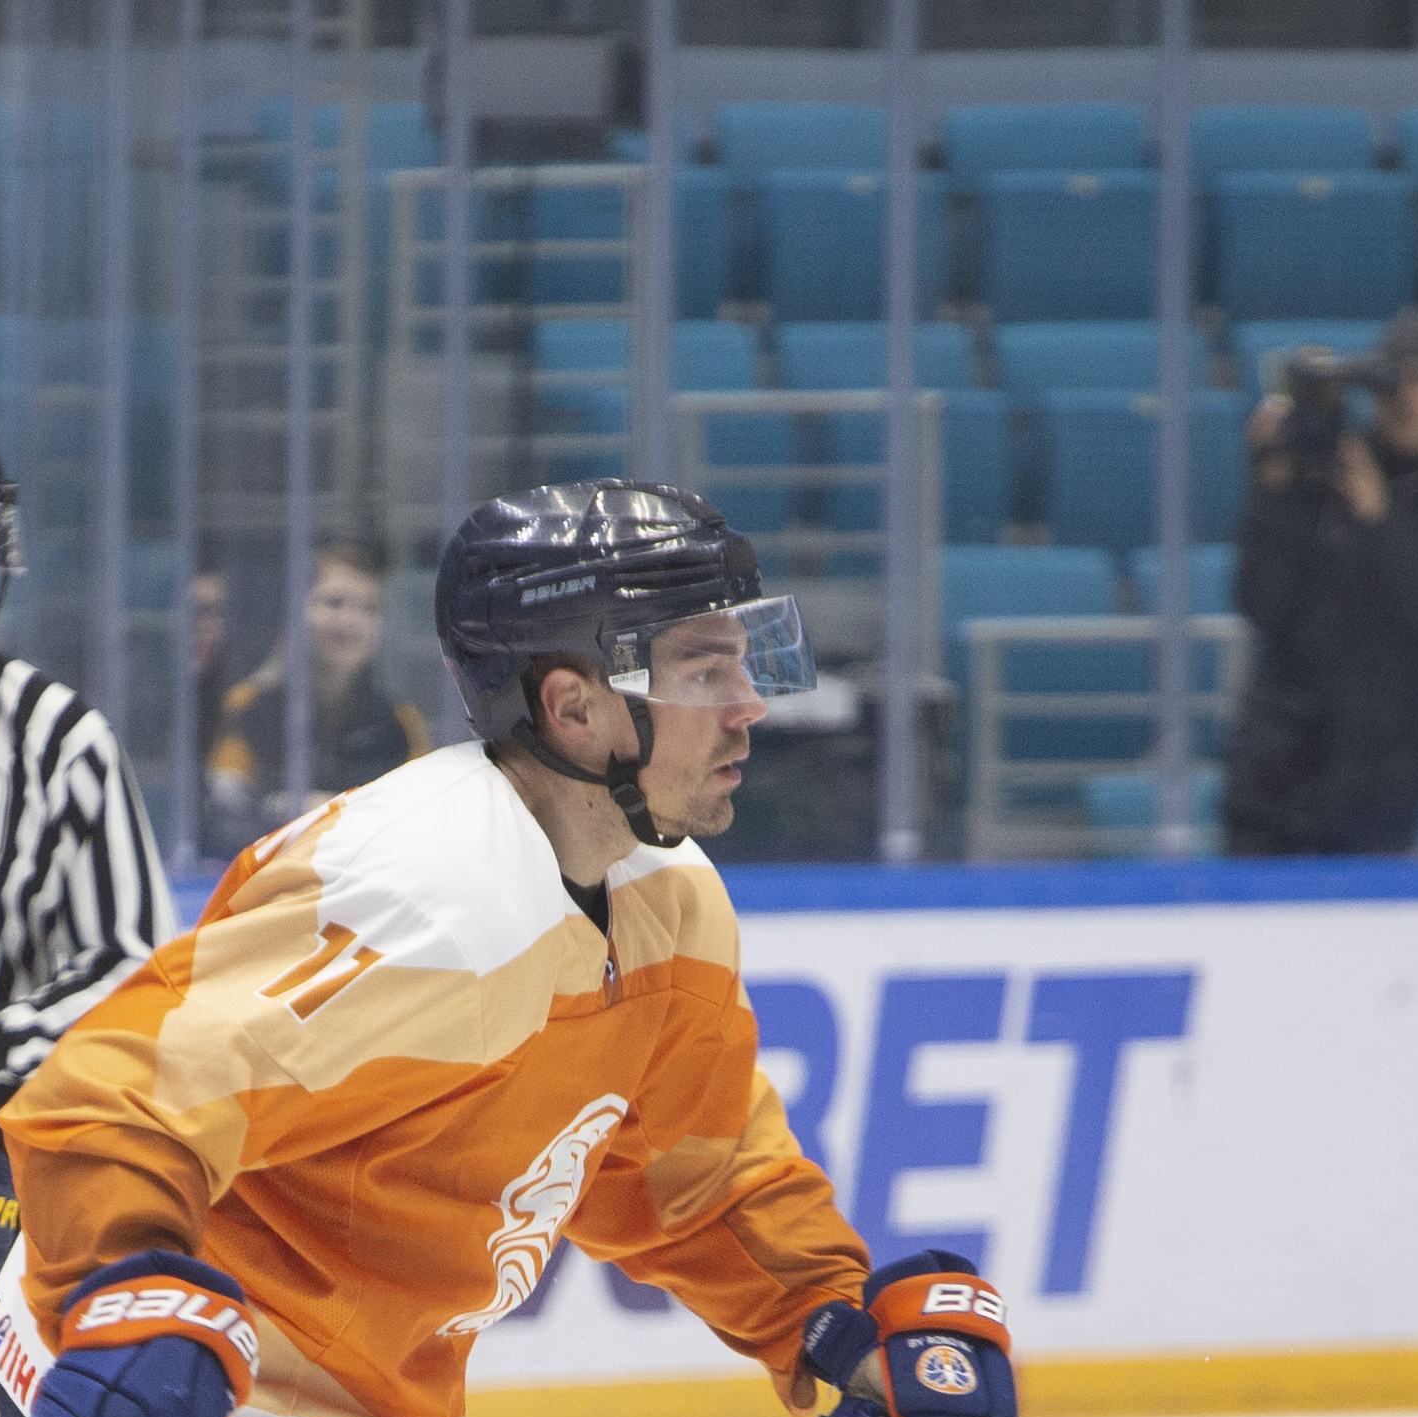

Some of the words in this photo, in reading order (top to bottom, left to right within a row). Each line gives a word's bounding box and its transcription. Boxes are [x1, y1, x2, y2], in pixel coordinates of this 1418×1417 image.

[520, 573, 597, 606] BAUER
[255, 918, 387, 1025] 11
[76, 1288, 261, 1378] BAUE
